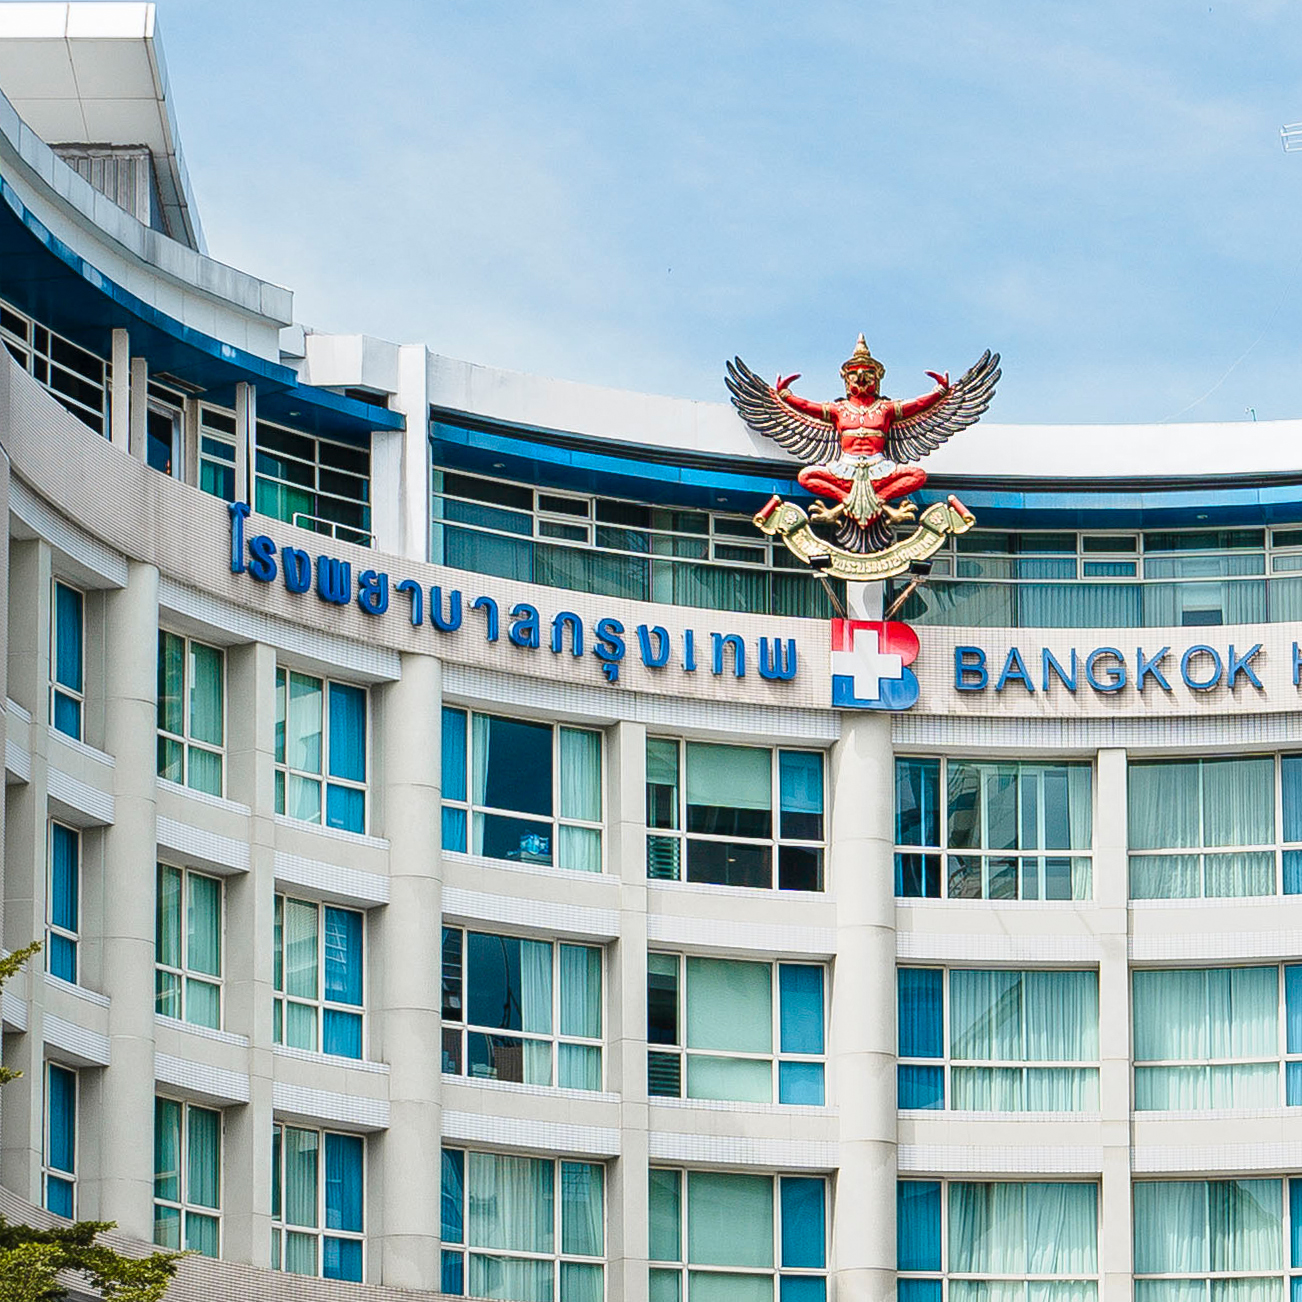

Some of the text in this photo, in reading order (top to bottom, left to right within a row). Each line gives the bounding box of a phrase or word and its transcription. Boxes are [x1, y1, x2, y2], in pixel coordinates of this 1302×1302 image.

[227, 501, 798, 682] โรงพยาบาลกรุงเทพ
[953, 643, 1266, 694] BANGKOK
